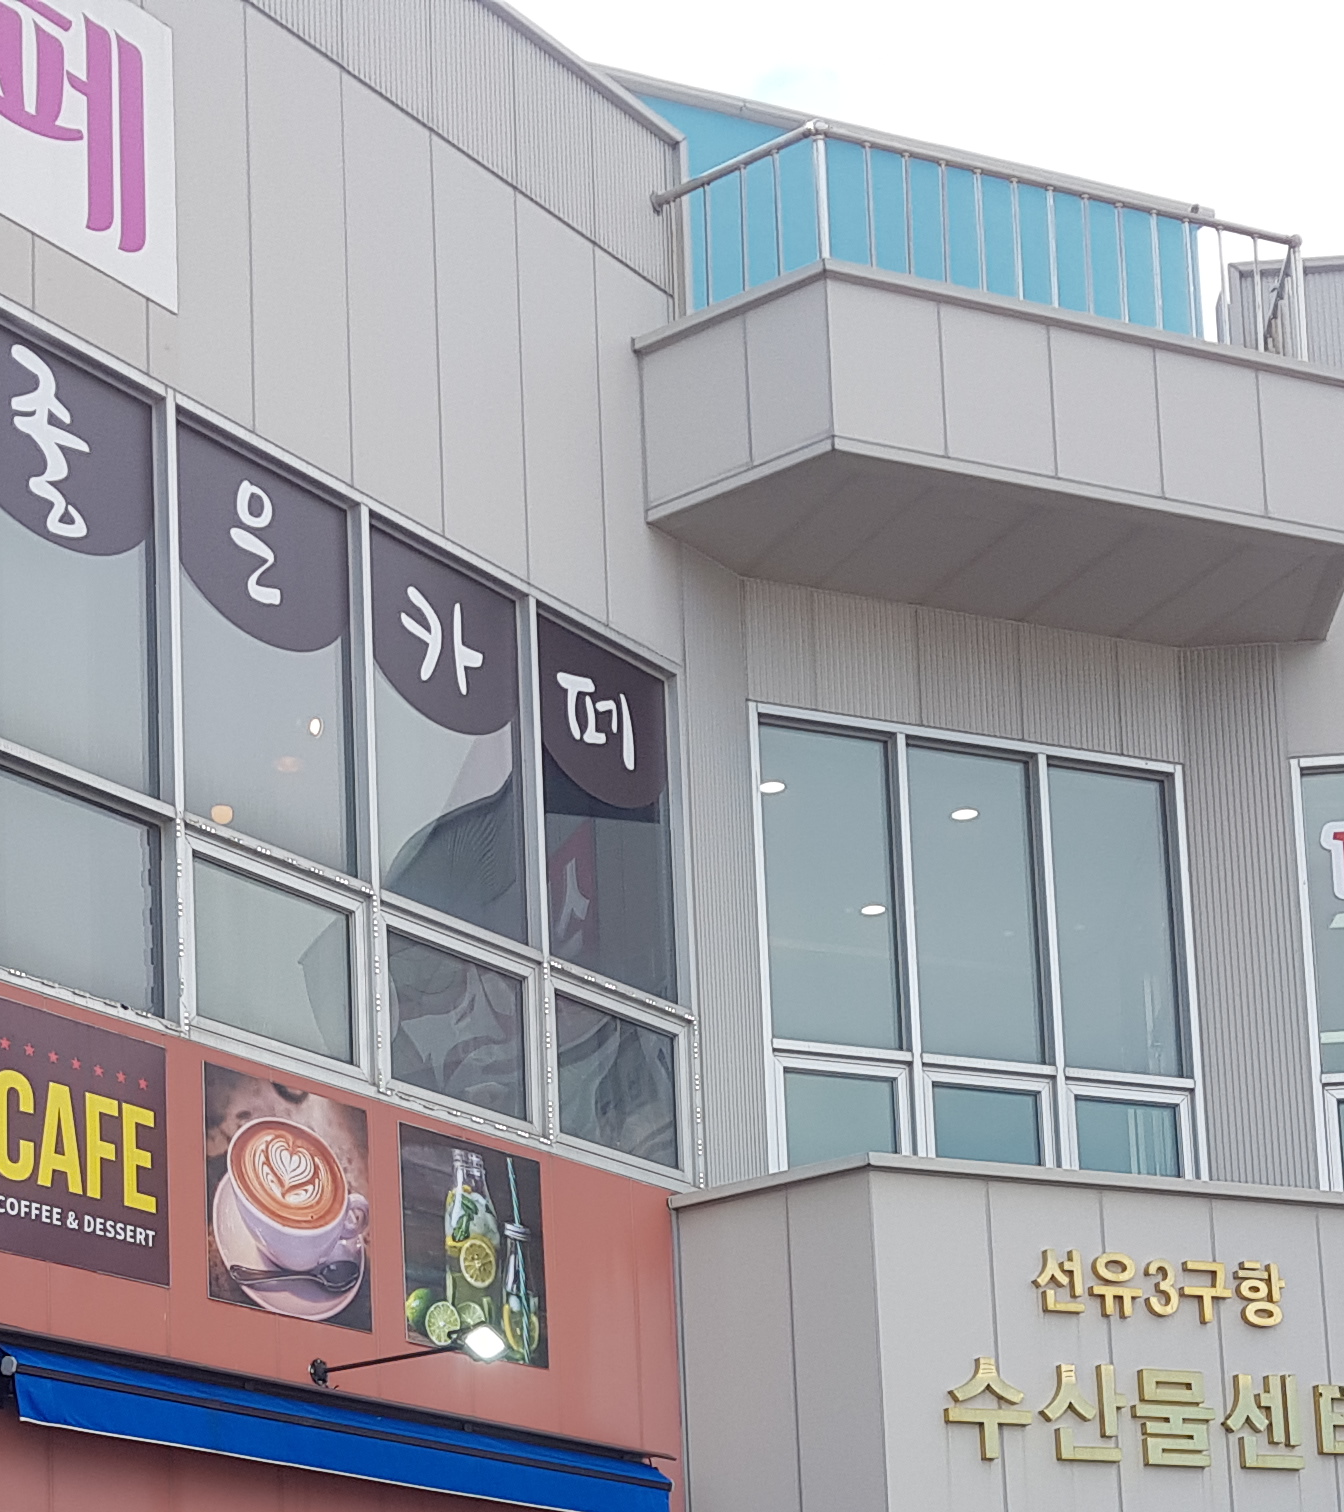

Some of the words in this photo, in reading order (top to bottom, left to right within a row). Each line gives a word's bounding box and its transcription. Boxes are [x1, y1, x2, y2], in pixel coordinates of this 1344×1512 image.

[66, 1211, 79, 1230] &
[83, 1214, 156, 1247] DESSERT
[1031, 1247, 1286, 1328] 선유3구항
